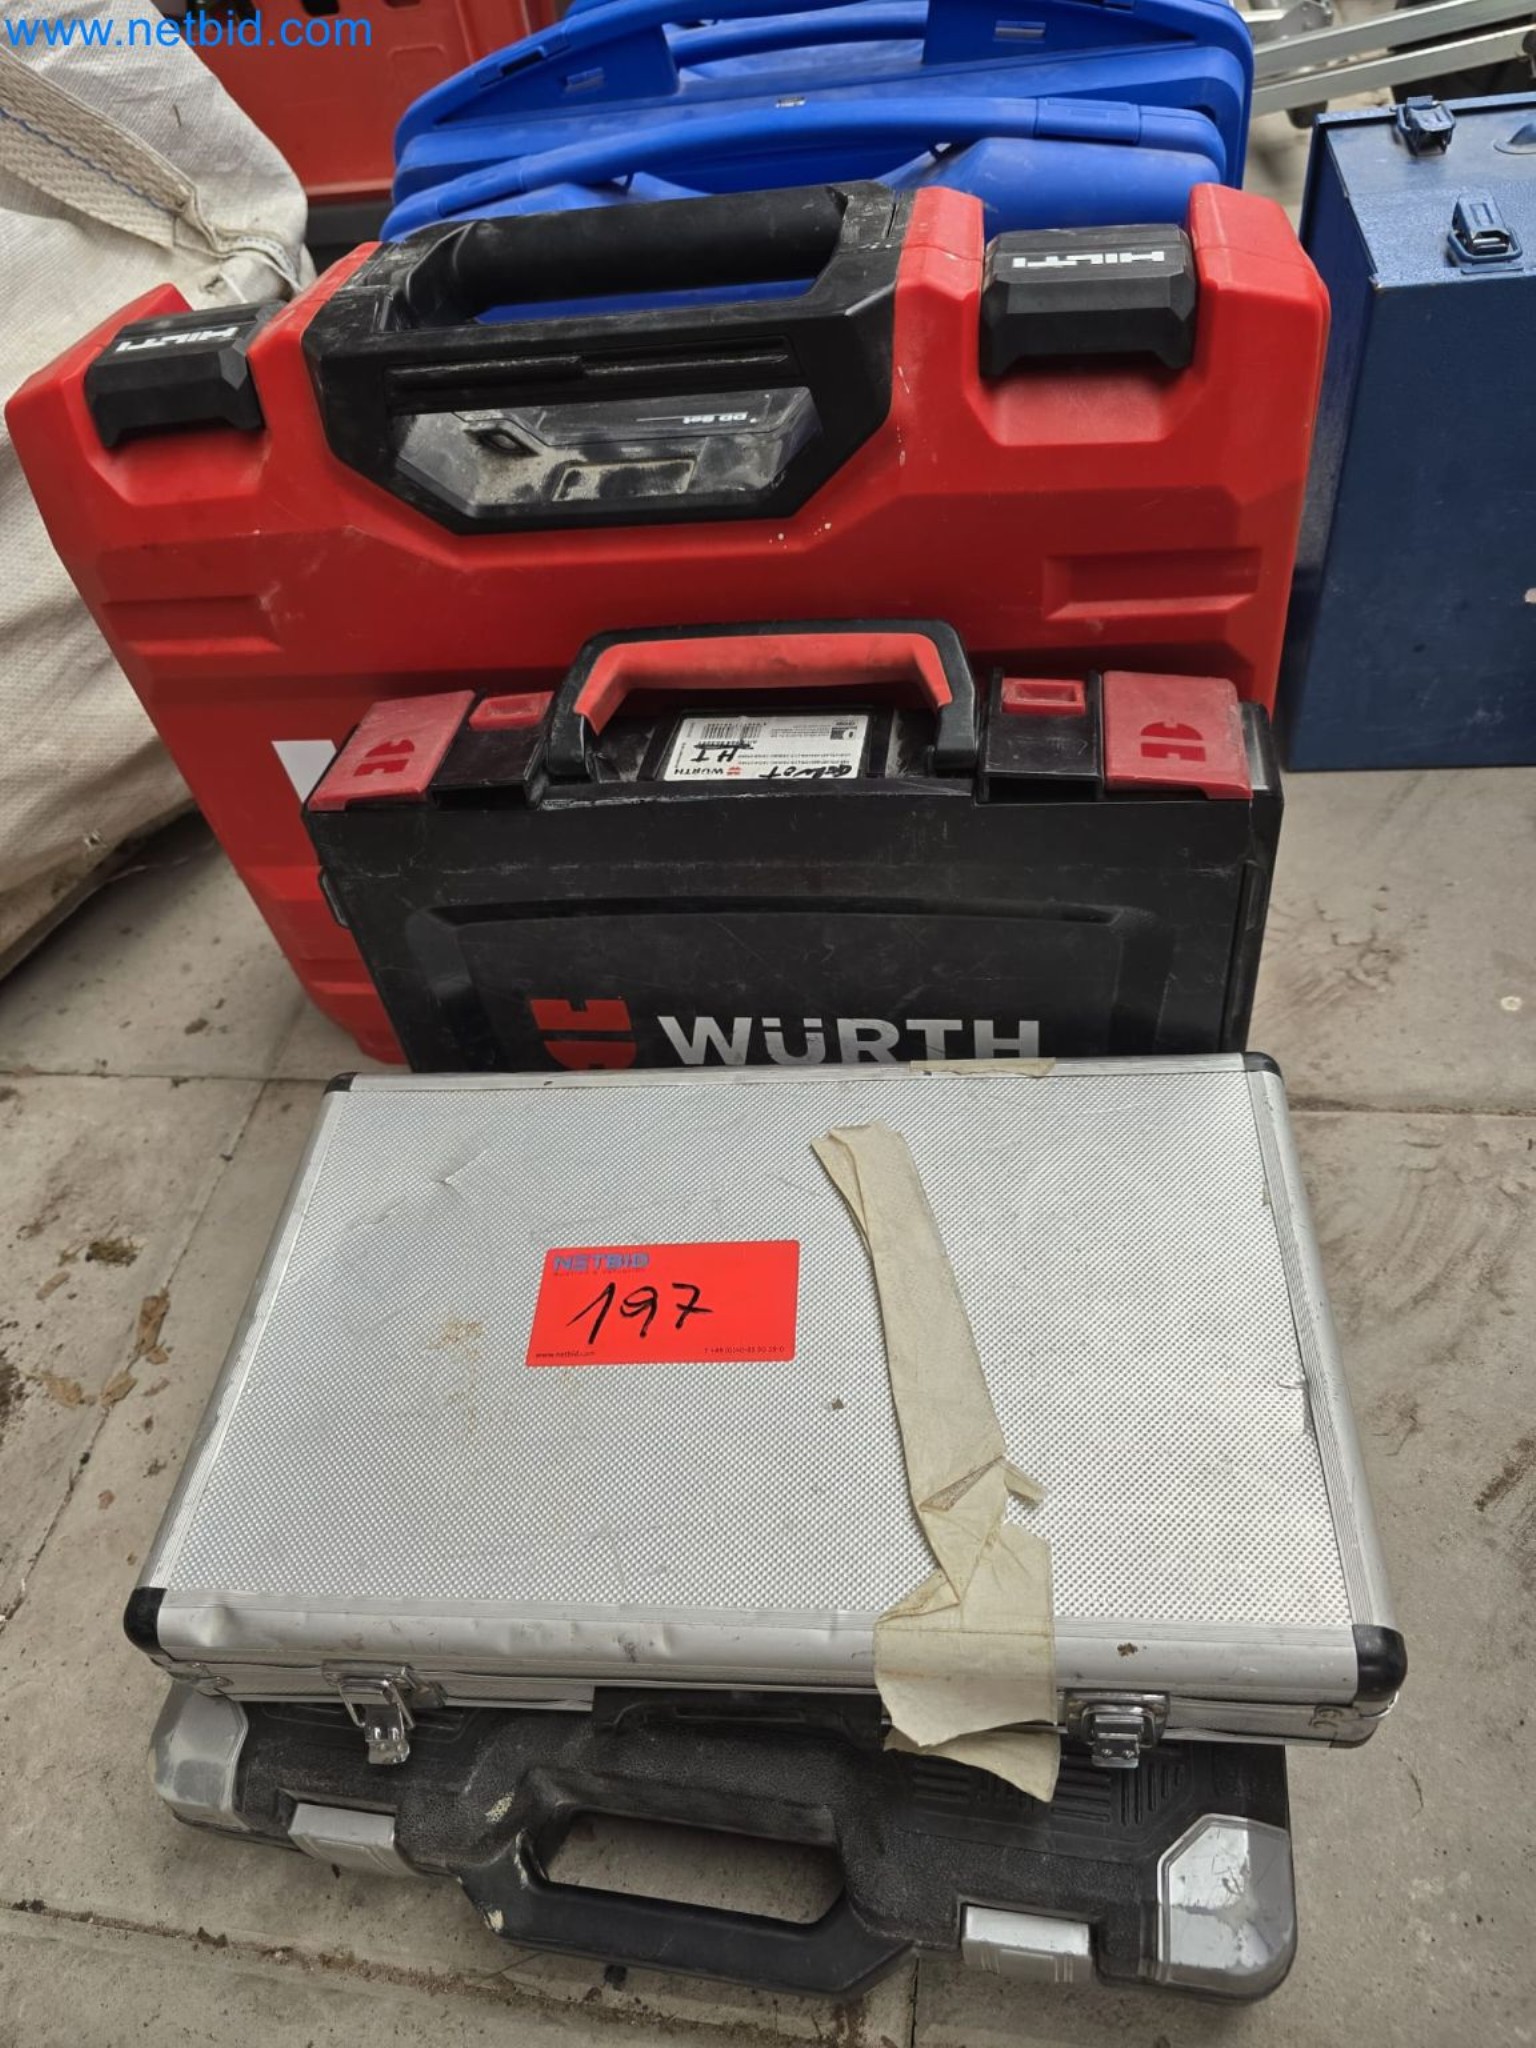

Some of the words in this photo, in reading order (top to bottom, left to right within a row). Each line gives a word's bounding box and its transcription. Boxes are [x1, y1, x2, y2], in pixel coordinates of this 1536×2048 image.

[1012, 250, 1165, 270] HILTI
[115, 326, 239, 353] HILTI
[657, 1016, 1040, 1066] WÜRTH
[553, 1253, 650, 1272] NETBID
[566, 1282, 714, 1345] 197
